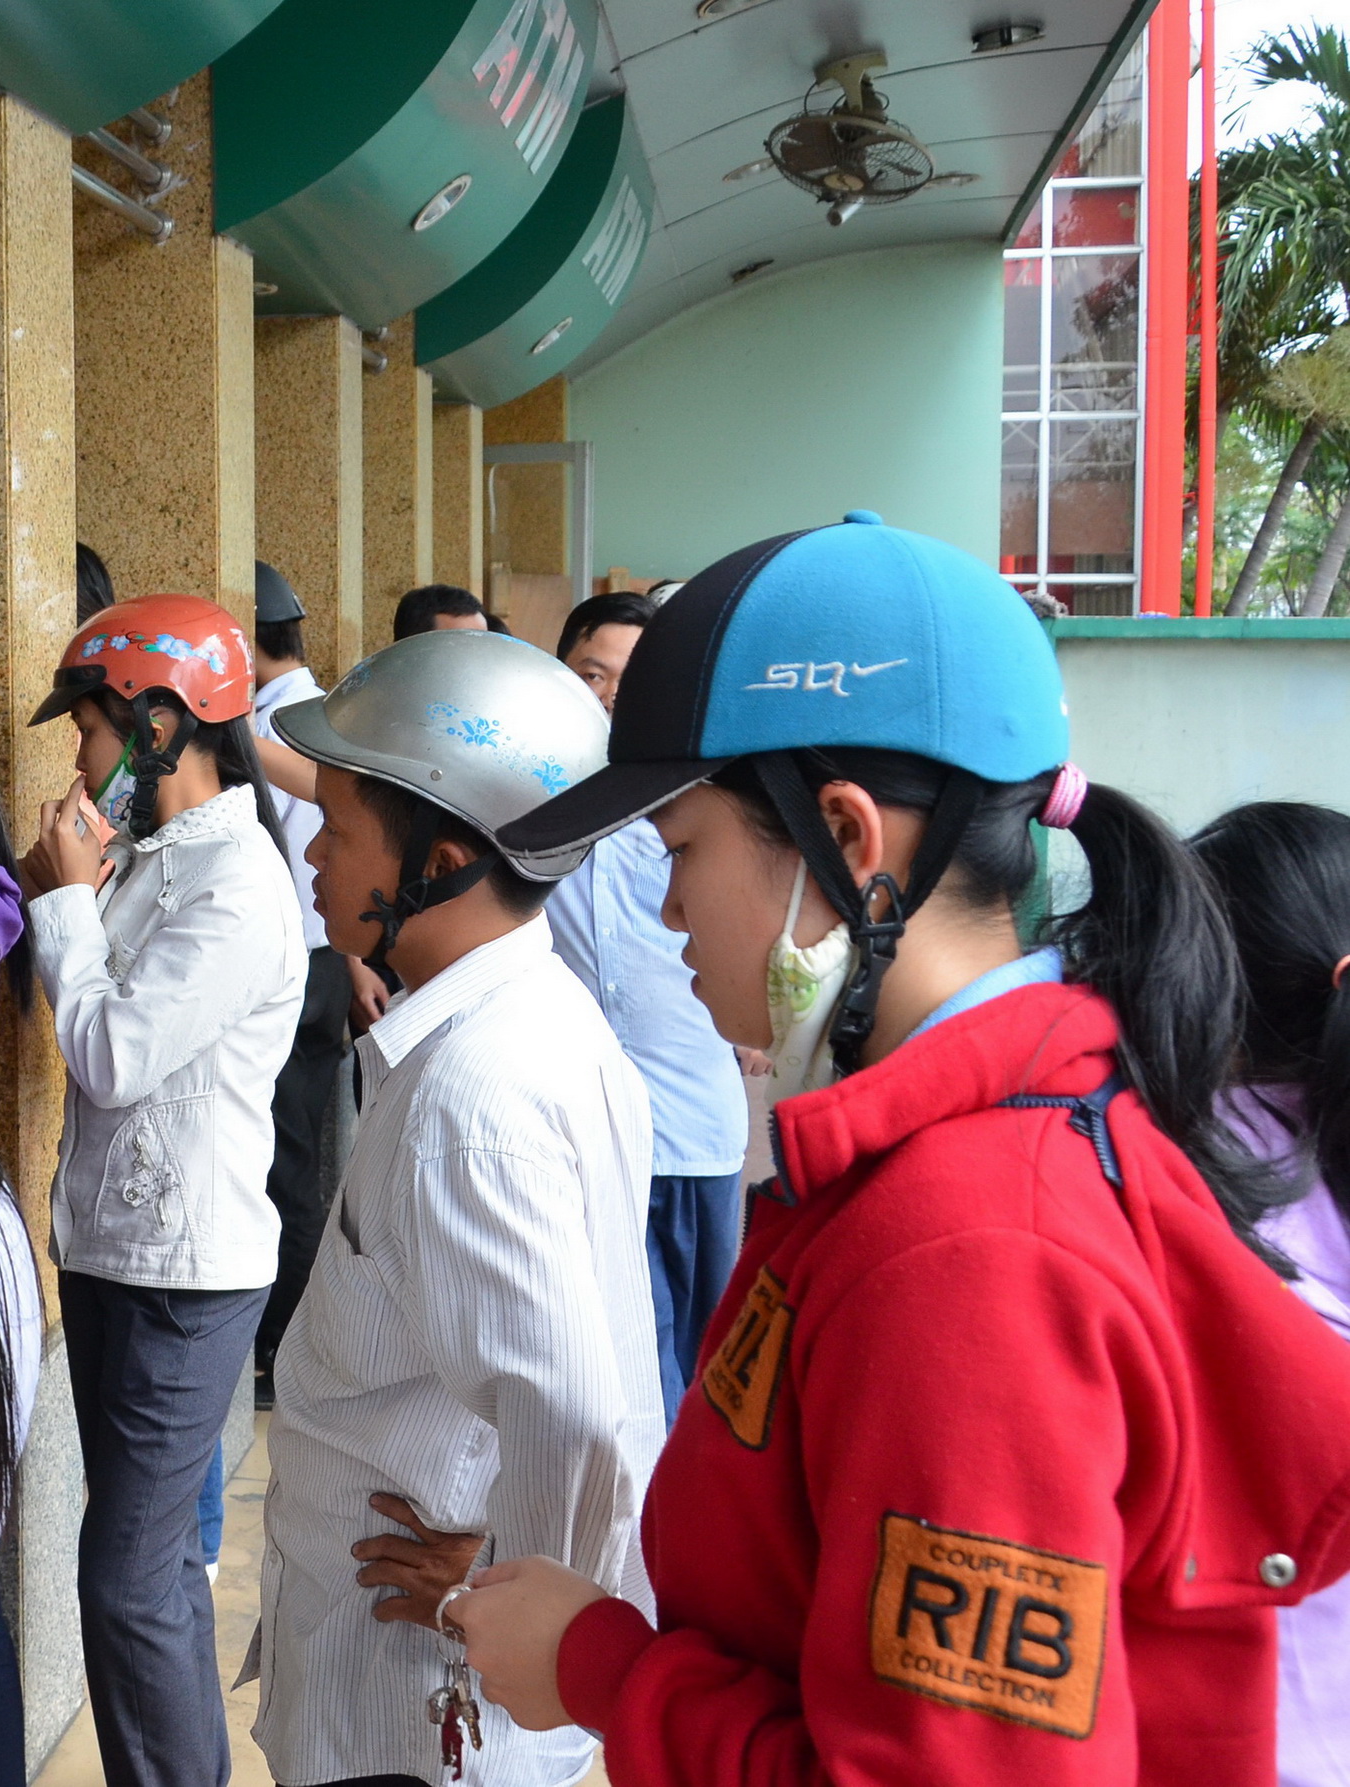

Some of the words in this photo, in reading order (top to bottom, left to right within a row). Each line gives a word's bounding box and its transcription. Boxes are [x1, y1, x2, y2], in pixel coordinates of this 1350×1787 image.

[472, 0, 585, 175] ATM
[581, 174, 646, 306] ATM
[897, 1564, 1074, 1680] RIB
[900, 1651, 1057, 1708] COLLECTION
